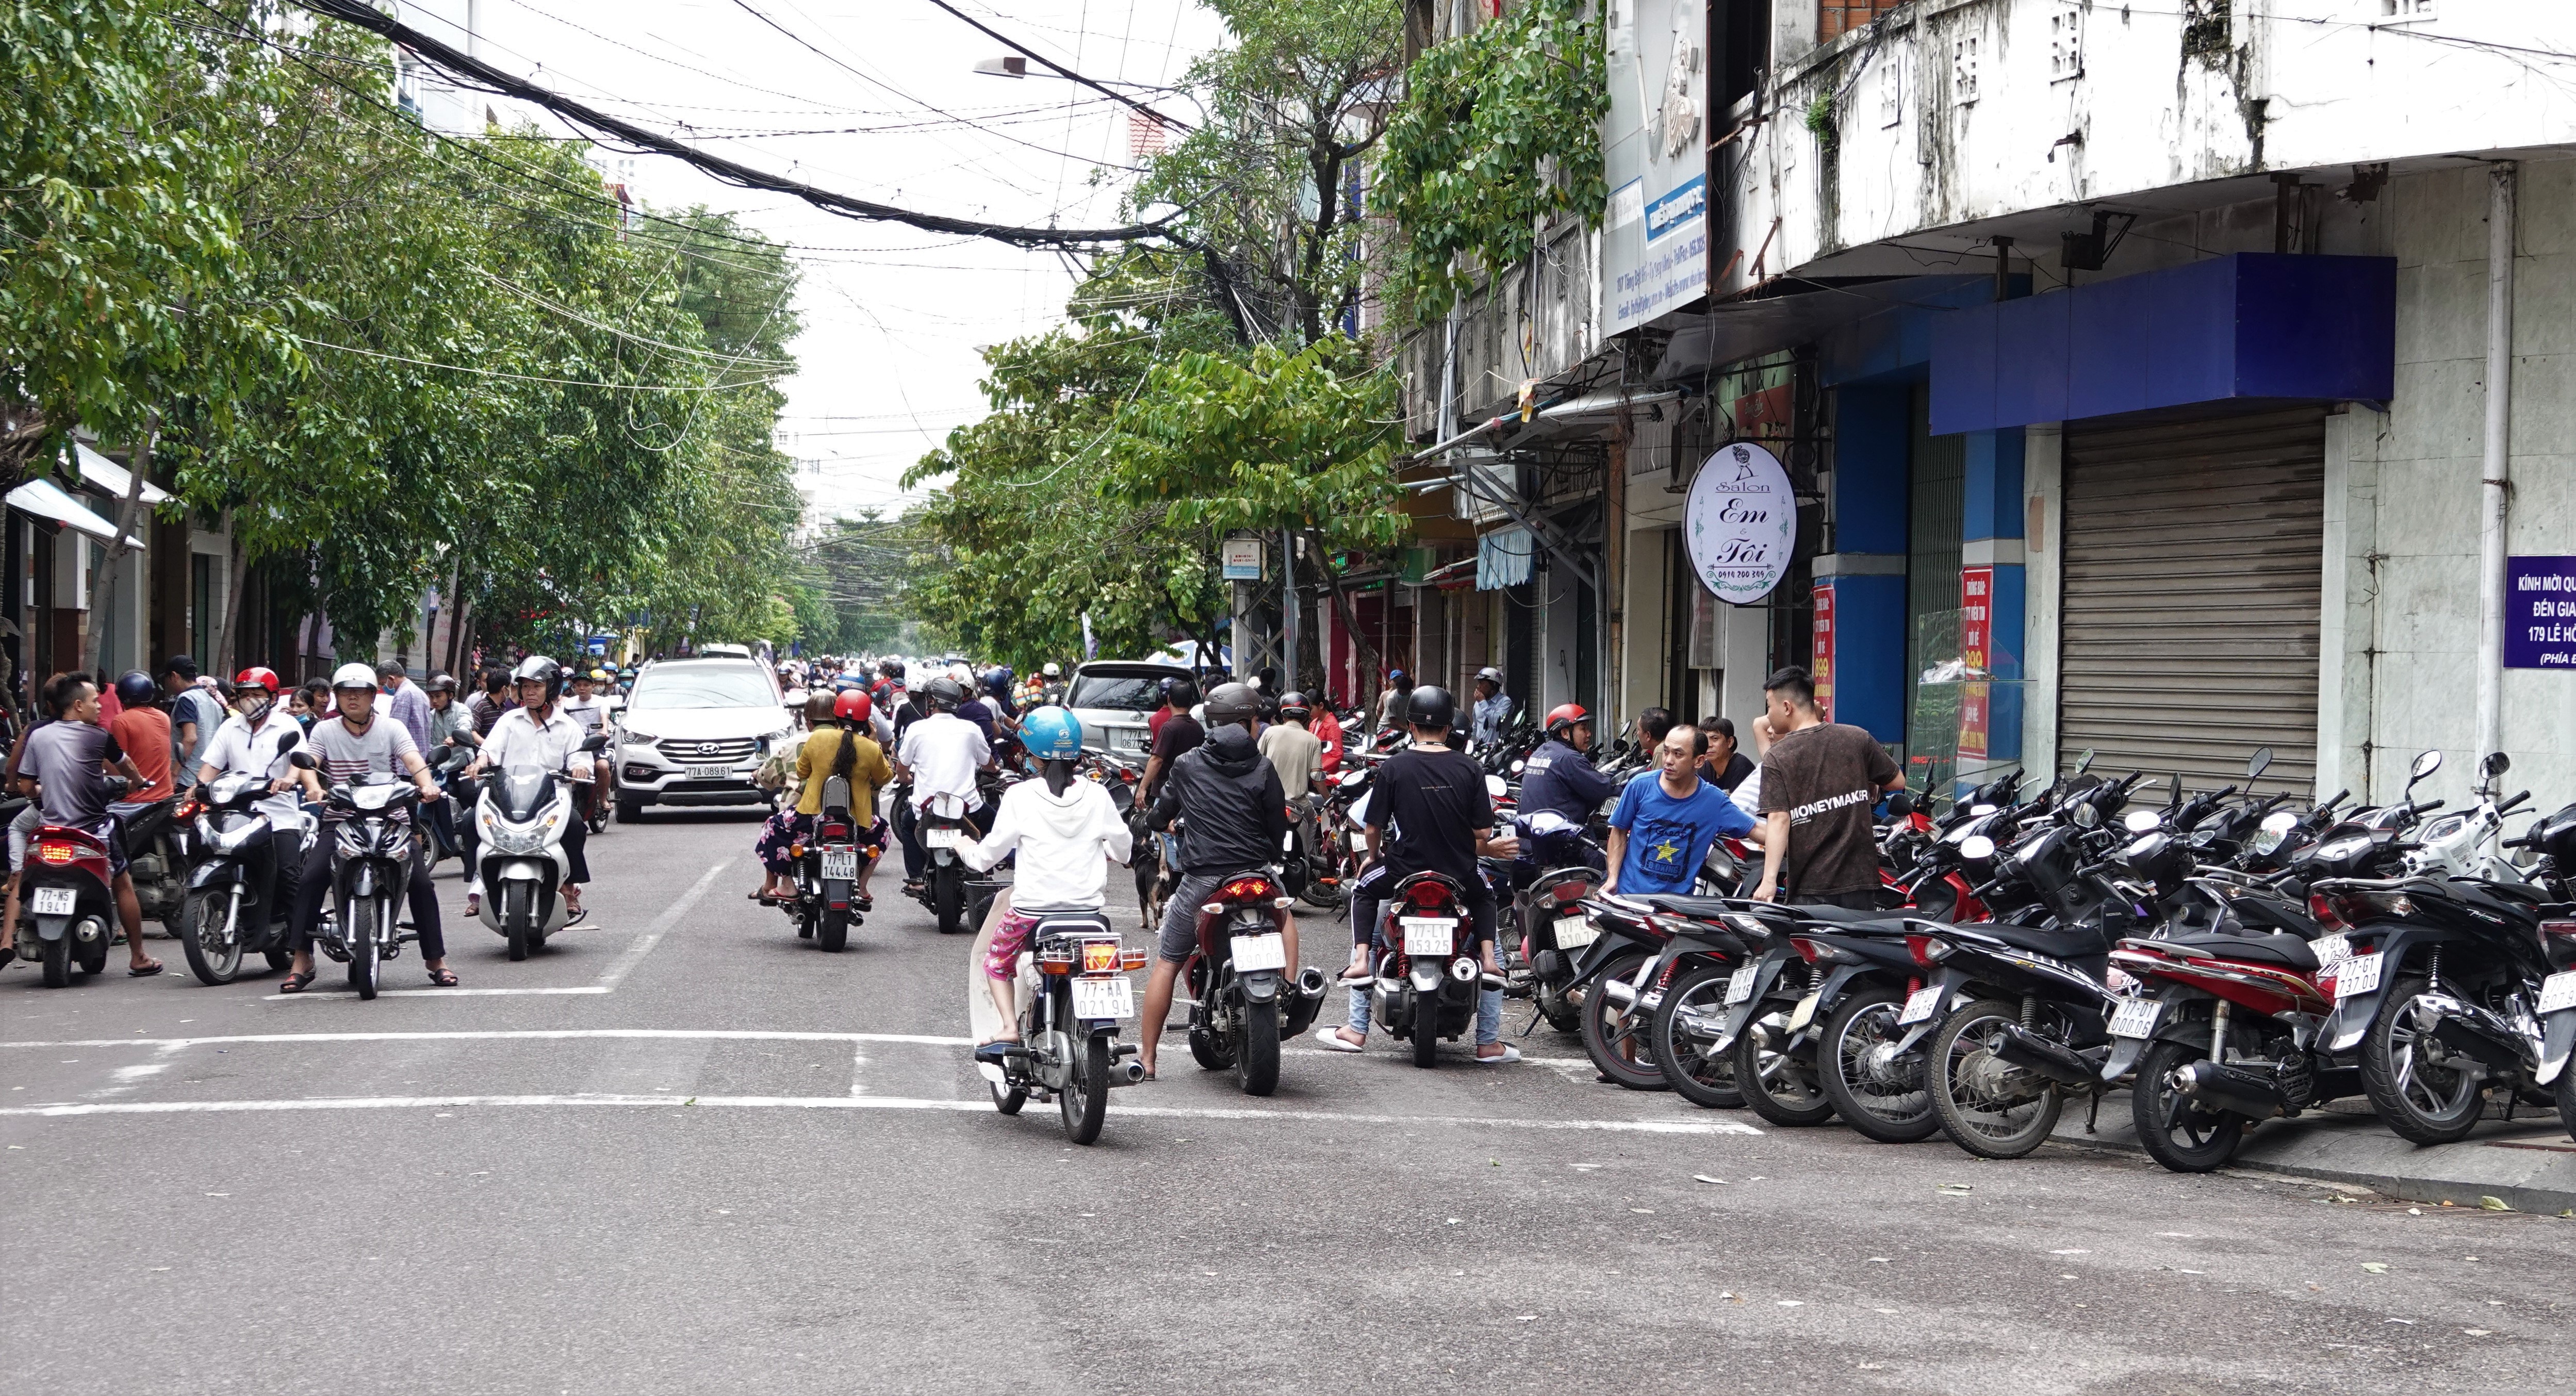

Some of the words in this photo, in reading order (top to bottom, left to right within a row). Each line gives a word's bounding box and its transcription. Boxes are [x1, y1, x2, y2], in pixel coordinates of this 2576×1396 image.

[1716, 482, 1769, 491] Salon
[1719, 498, 1769, 523] Em
[1717, 538, 1767, 563] Tôi
[2518, 573, 2541, 590] KÍNH
[2542, 573, 2562, 590] MỜI
[2533, 598, 2555, 617] ĐẾN
[2557, 602, 2576, 617] GIA
[2528, 627, 2545, 642] 179
[2547, 622, 2561, 642] LÊ
[1815, 658, 1829, 677] 899
[2540, 652, 2569, 666] (PHÍA
[1122, 739, 1143, 748] 067.6
[687, 767, 730, 776] 77A-089.61
[1790, 790, 1868, 820] MONEYMAKER
[828, 855, 851, 865] 77-L1
[825, 866, 855, 877] 144.48
[40, 902, 67, 912] 1941
[1414, 925, 1445, 938] 77-L1
[1561, 918, 1586, 933] 77-L
[1240, 939, 1273, 952] 77-F1
[1408, 940, 1449, 953] 053.25
[2314, 935, 2343, 952] 77-G1
[2345, 957, 2374, 977] 77-G1
[1082, 982, 1122, 997] 77-AA
[2339, 973, 2375, 995] 737.00
[1728, 984, 1751, 1002] 112.15
[2542, 990, 2576, 1010] 607.9
[1079, 1000, 1129, 1015] 021.94
[2123, 1000, 2155, 1018] 77-D1
[2111, 1017, 2151, 1035] 000.06
